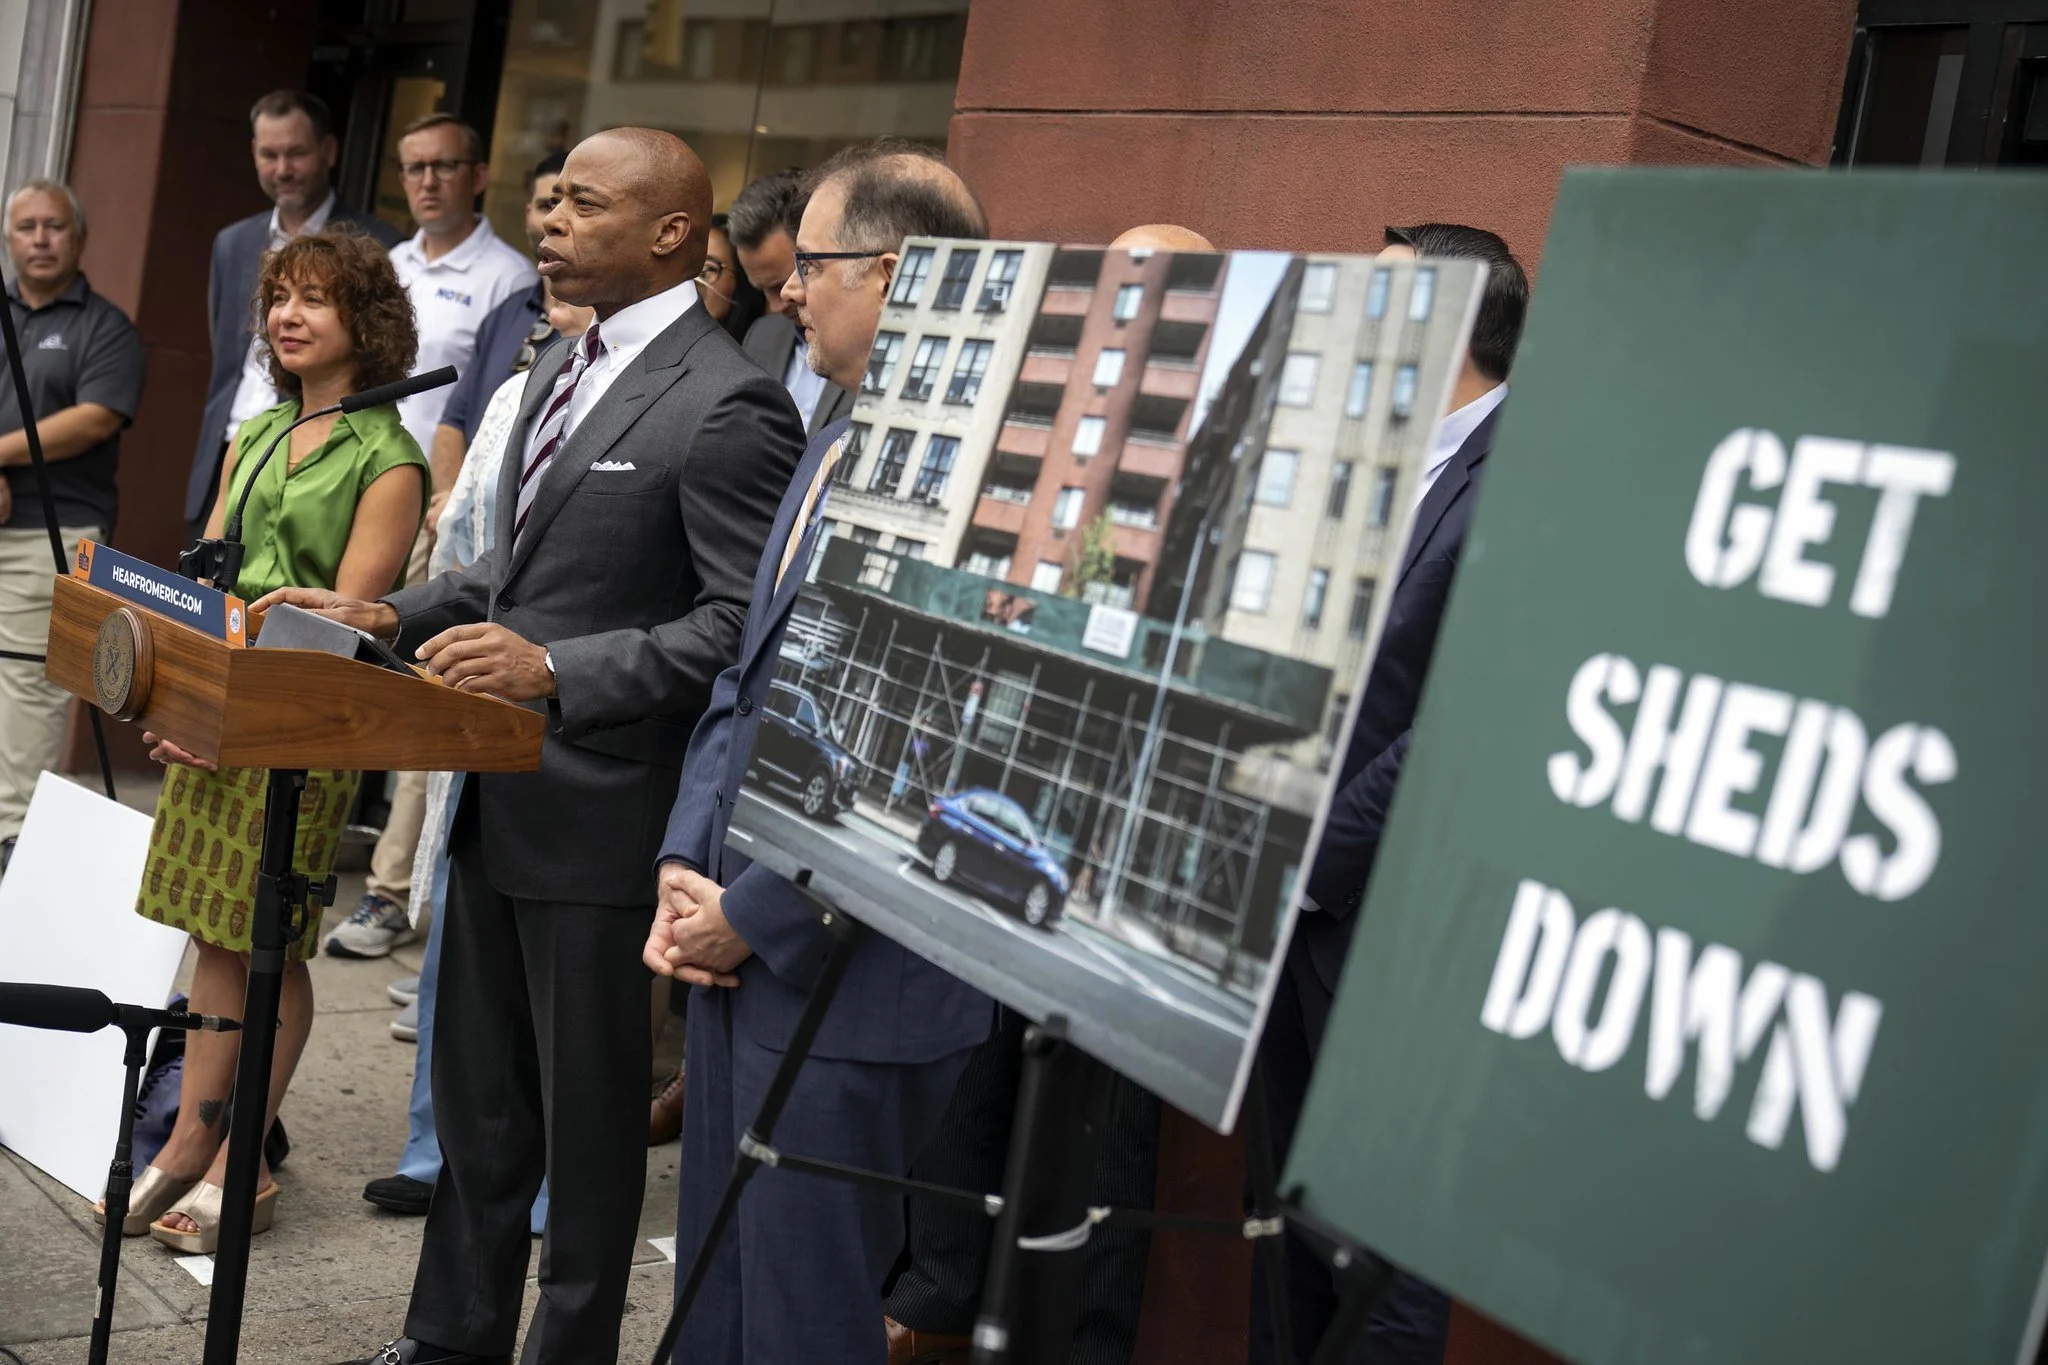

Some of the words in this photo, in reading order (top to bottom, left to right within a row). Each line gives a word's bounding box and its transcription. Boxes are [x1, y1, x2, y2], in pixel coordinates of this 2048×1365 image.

[112, 565, 203, 616] HEARFROMERIC.COM
[1684, 427, 1956, 618] GET
[1547, 652, 1957, 901] SHEDS
[1480, 878, 1883, 1172] DOWN
